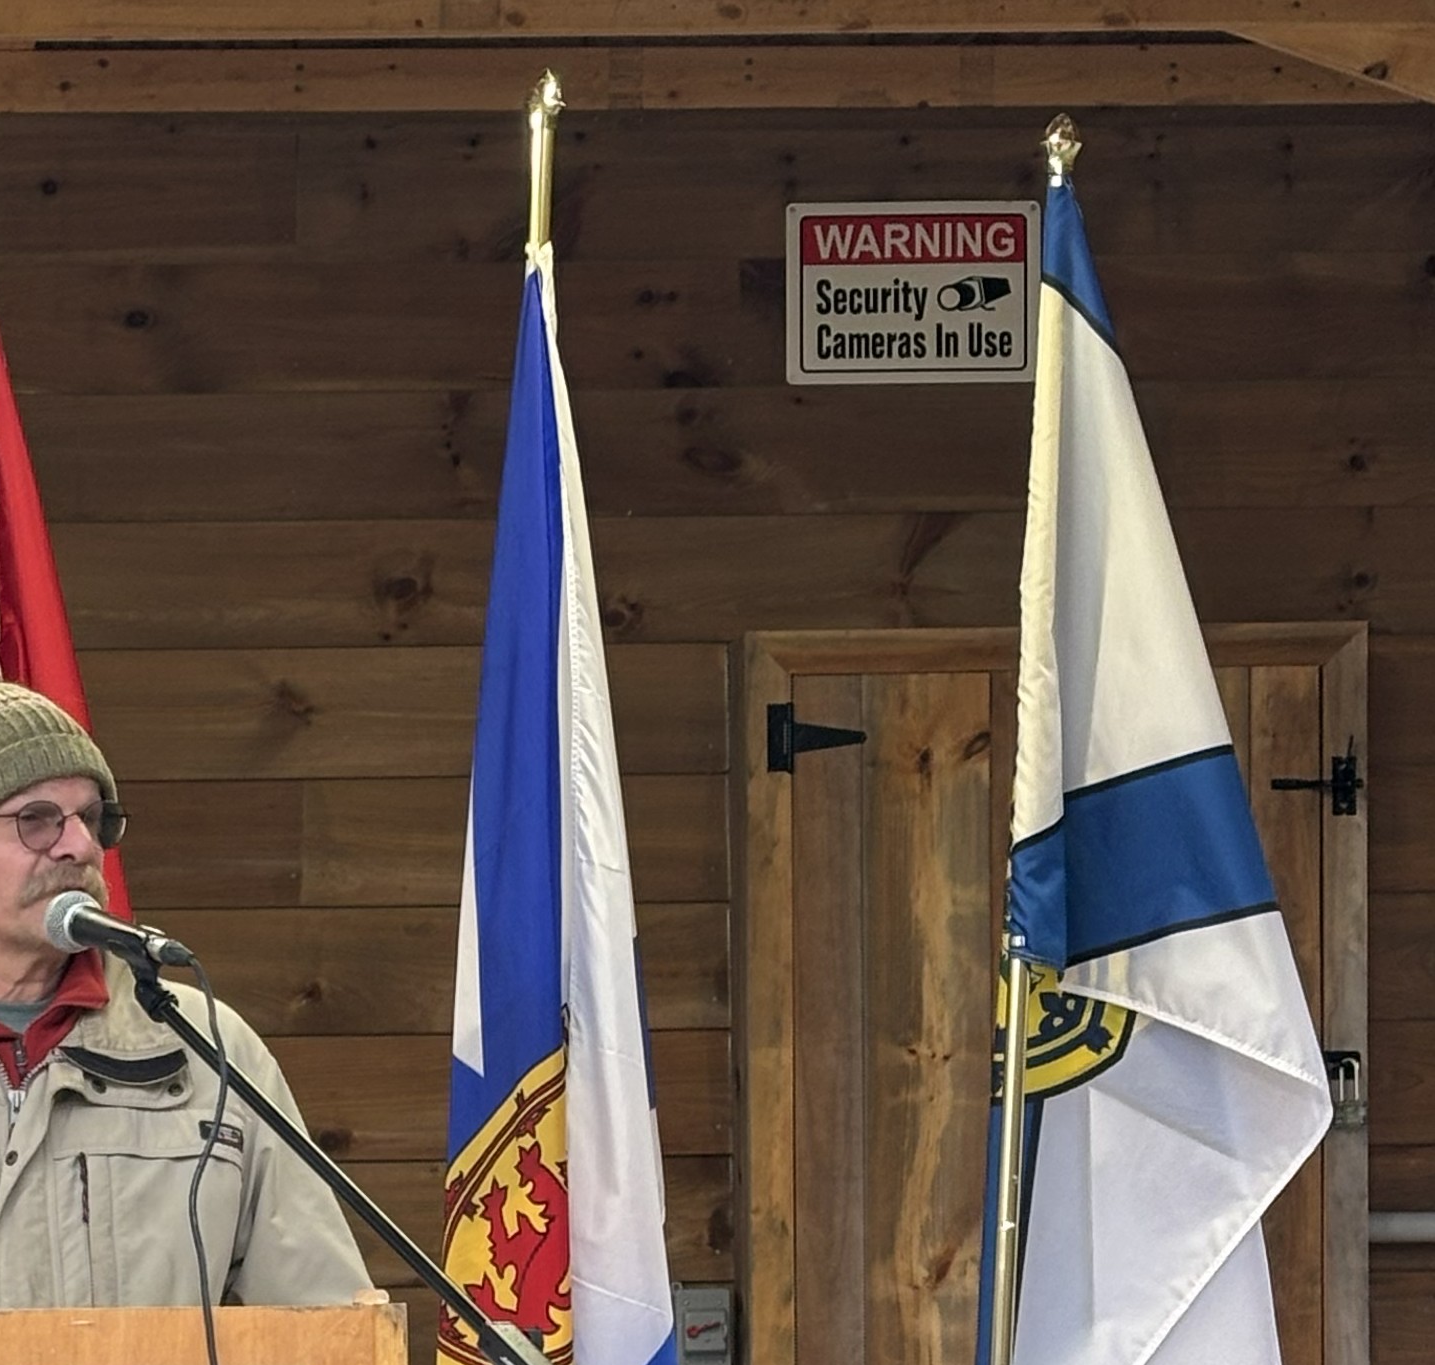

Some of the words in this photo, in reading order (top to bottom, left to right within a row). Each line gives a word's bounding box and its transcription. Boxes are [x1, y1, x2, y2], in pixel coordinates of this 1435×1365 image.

[814, 221, 1016, 260] WARNING
[816, 278, 928, 321] Security
[817, 323, 927, 359] Cameras
[936, 322, 959, 358] In
[969, 322, 1012, 358] Use
